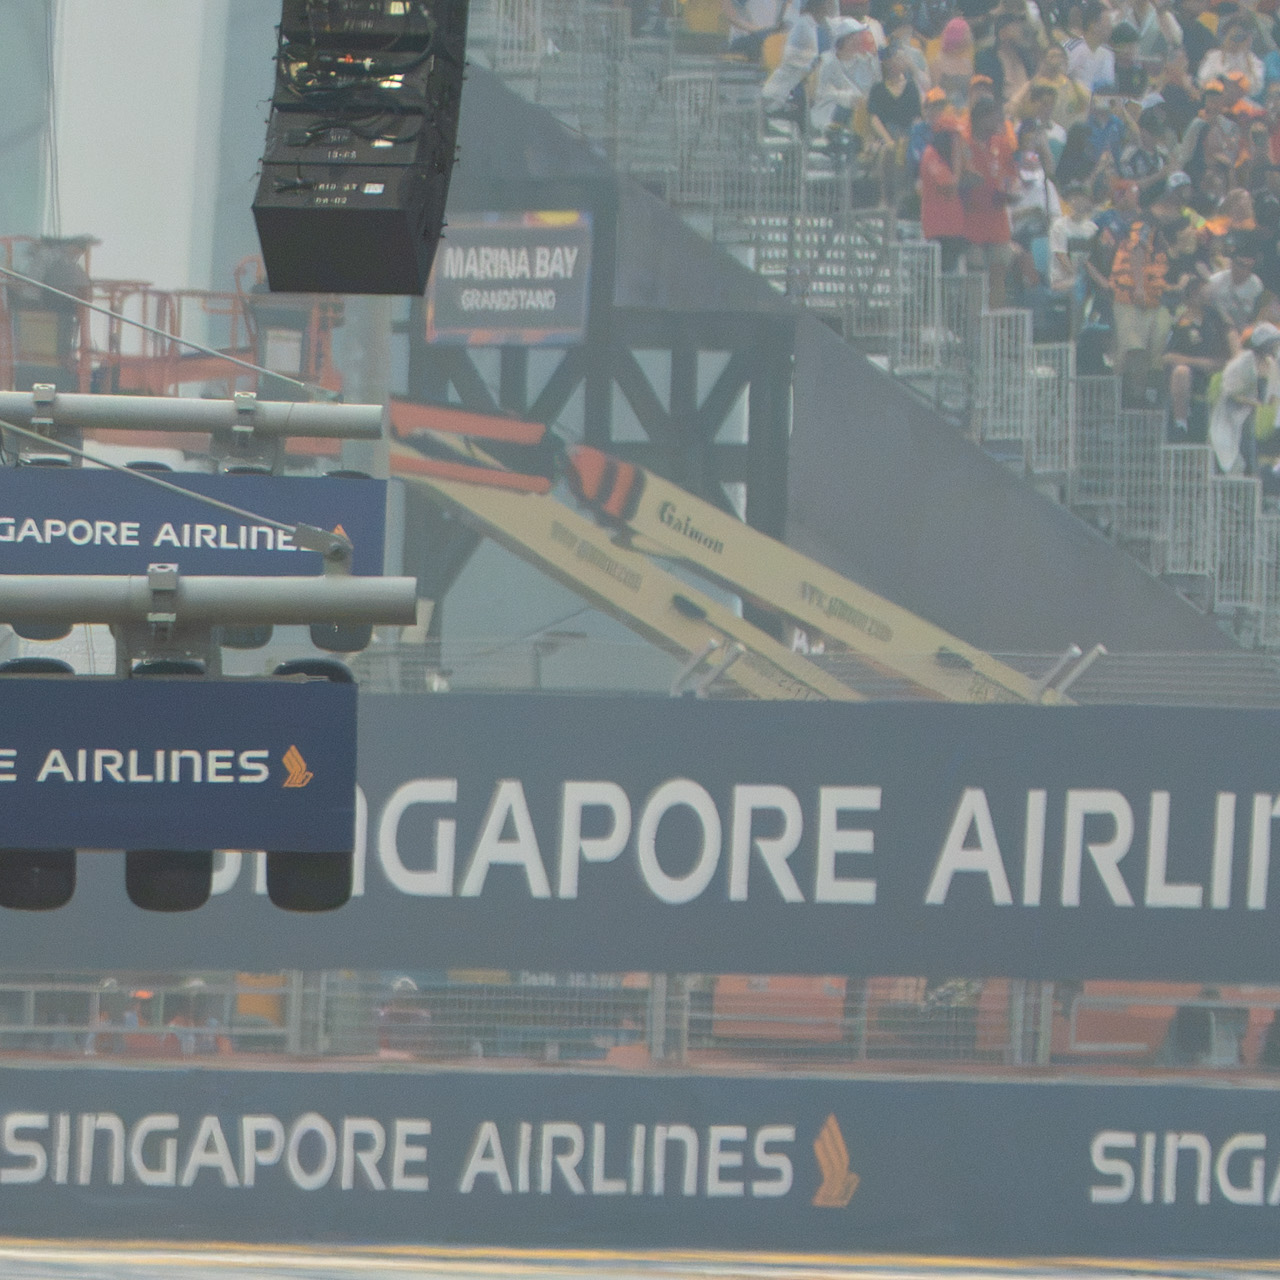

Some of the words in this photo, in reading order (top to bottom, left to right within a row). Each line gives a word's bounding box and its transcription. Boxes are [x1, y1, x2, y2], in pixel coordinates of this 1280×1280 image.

[444, 246, 530, 280] MARINA
[535, 246, 578, 279] BAY
[461, 288, 556, 312] GRANDSTAND
[152, 521, 313, 551] AIRLINE
[37, 747, 270, 784] AIRLINES
[211, 778, 882, 904] GAPORE
[459, 1121, 795, 1197] AIRLINES
[1090, 1129, 1280, 1206] SING
